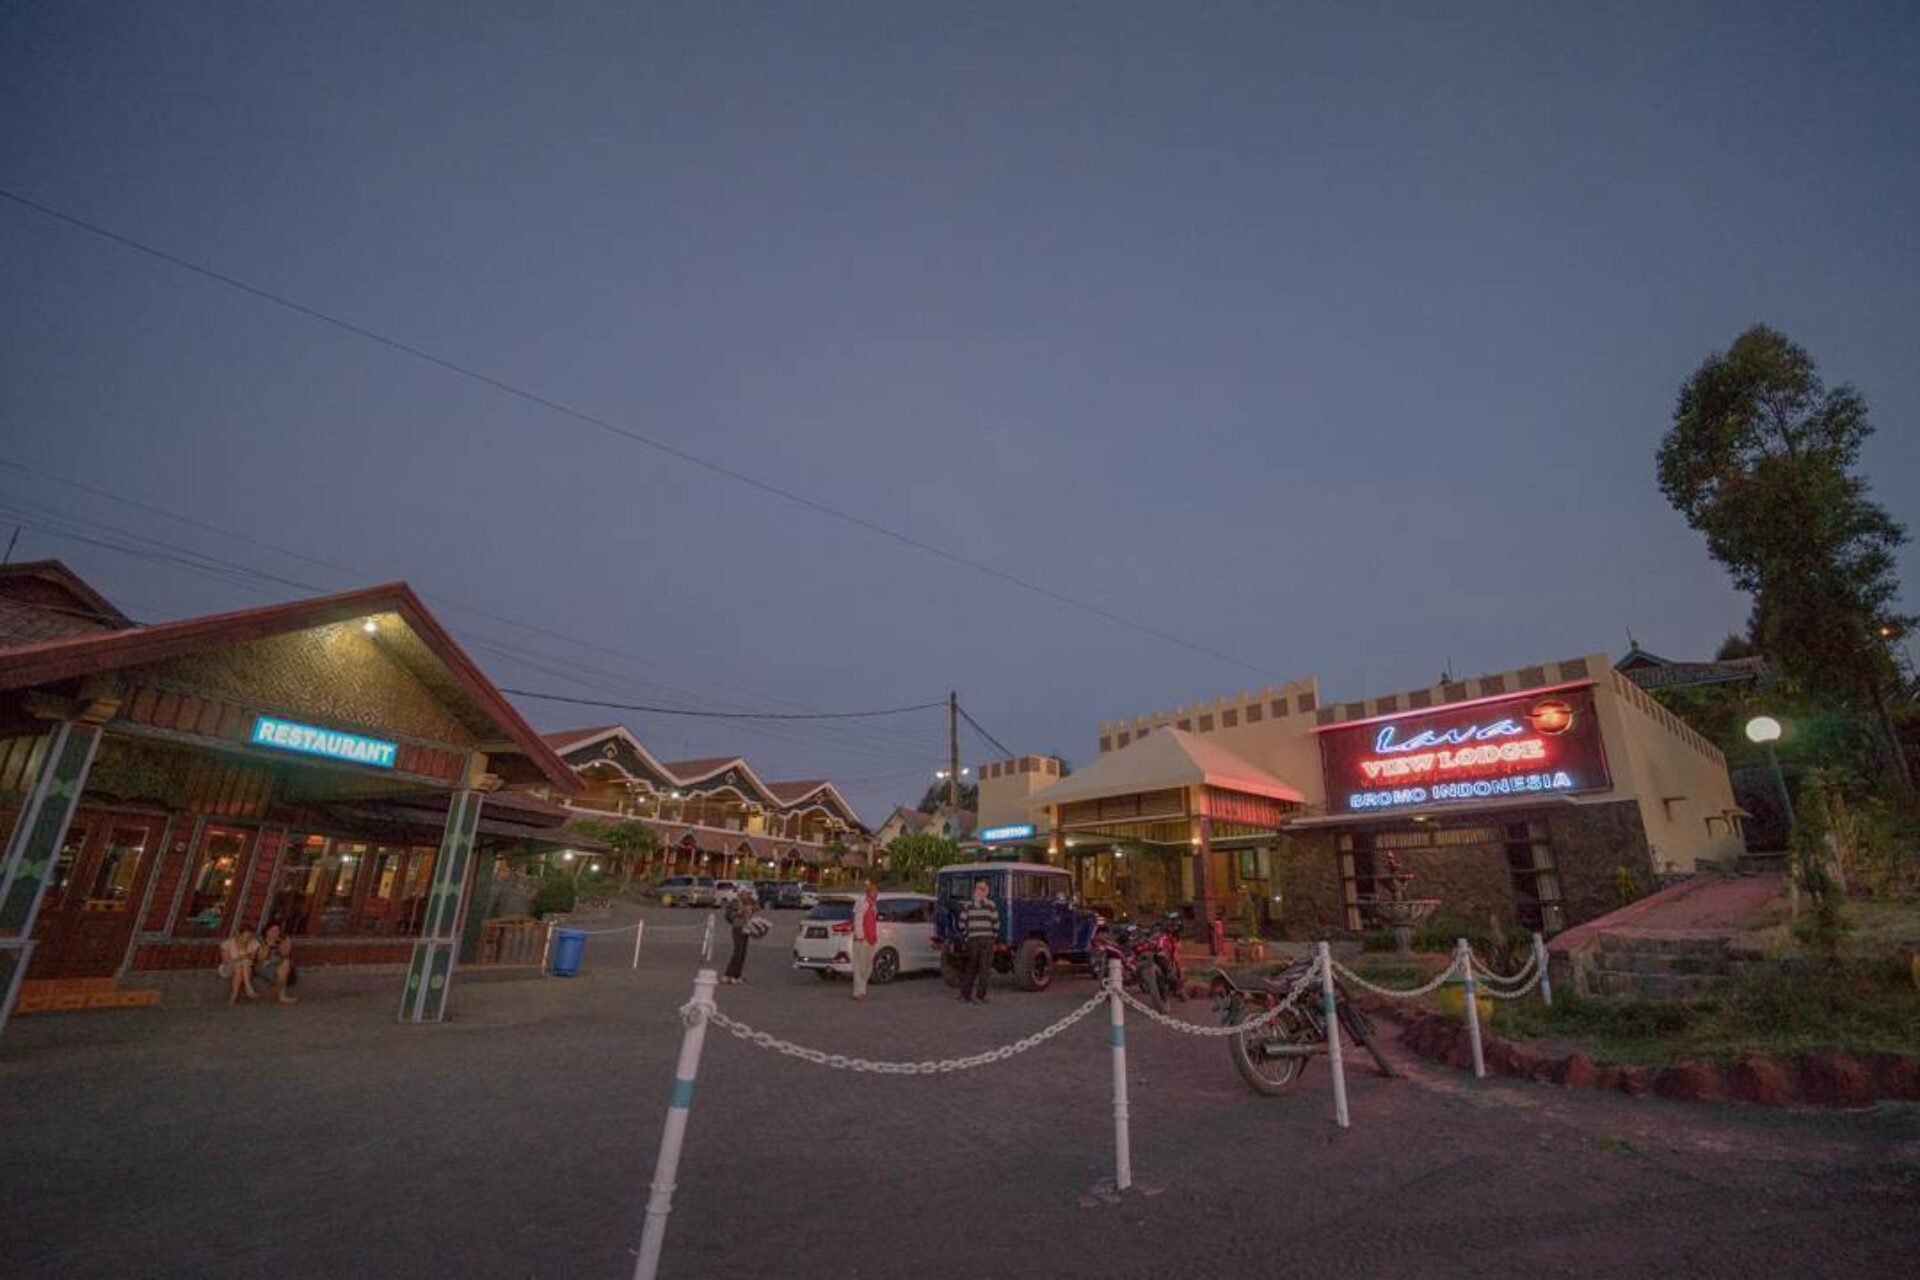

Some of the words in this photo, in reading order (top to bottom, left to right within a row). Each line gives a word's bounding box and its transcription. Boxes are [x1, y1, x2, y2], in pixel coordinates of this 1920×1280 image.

[259, 721, 393, 762] RESTAURANT
[1376, 719, 1522, 752] Lava
[1361, 754, 1434, 778] VIEW
[1438, 740, 1545, 768] LODGE
[1351, 787, 1425, 808] BROMO
[1432, 772, 1571, 798] INDONESIA
